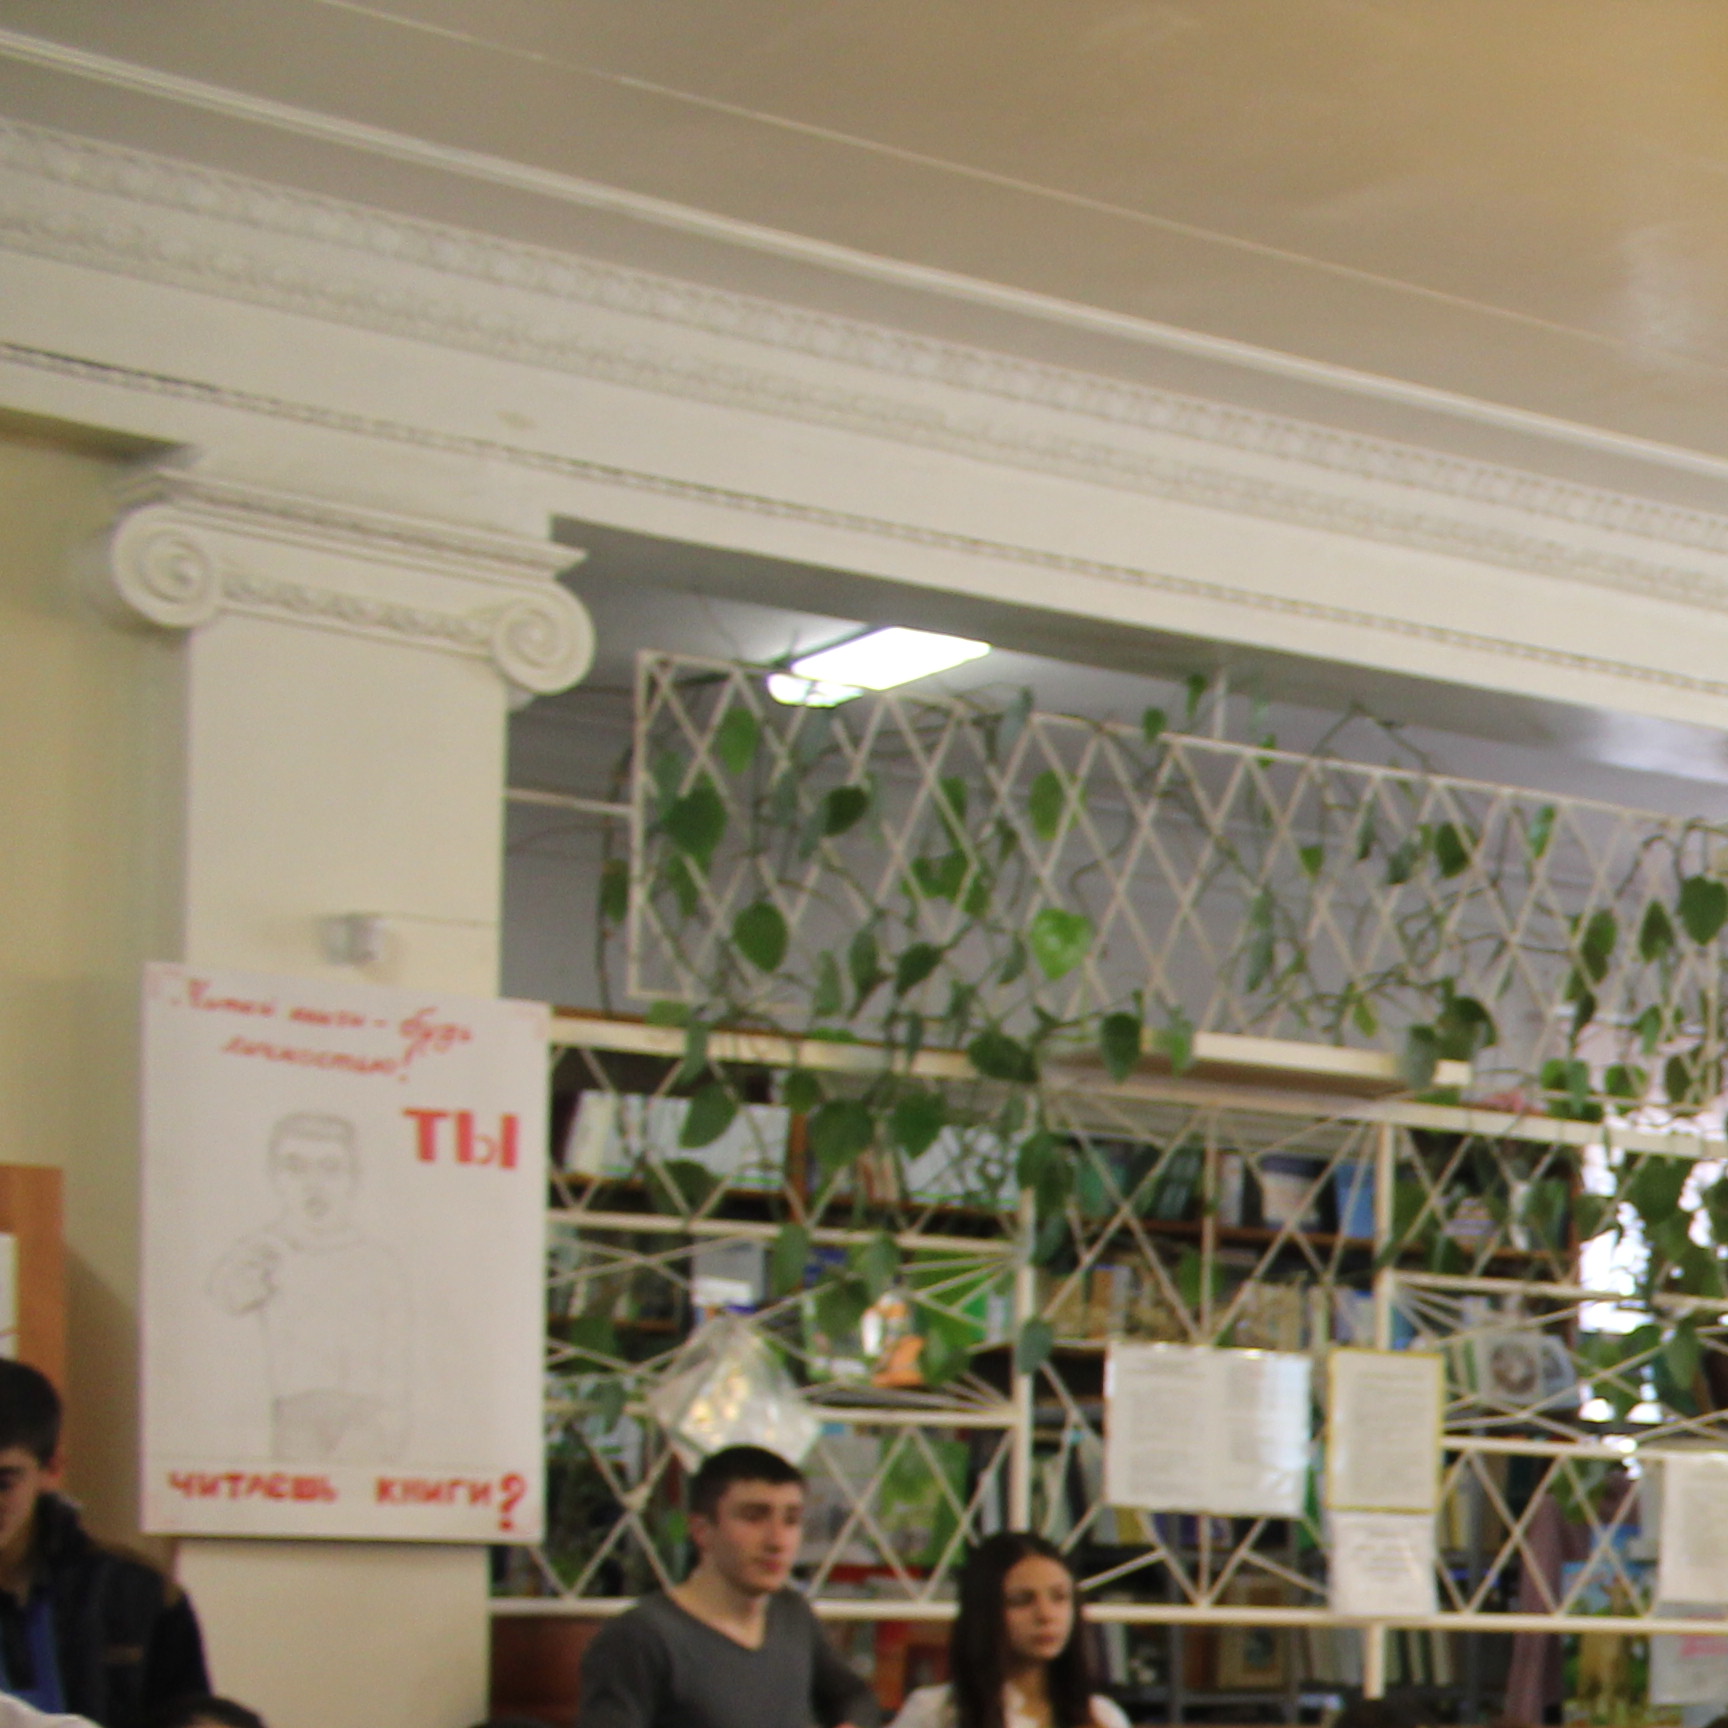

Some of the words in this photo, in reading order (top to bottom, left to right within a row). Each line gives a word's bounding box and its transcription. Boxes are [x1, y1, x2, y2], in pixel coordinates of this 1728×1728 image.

[403, 1108, 519, 1168] ТЫ
[168, 1471, 339, 1504] ЧИТАЕШЬ
[374, 1471, 528, 1532] КНИГИ?
